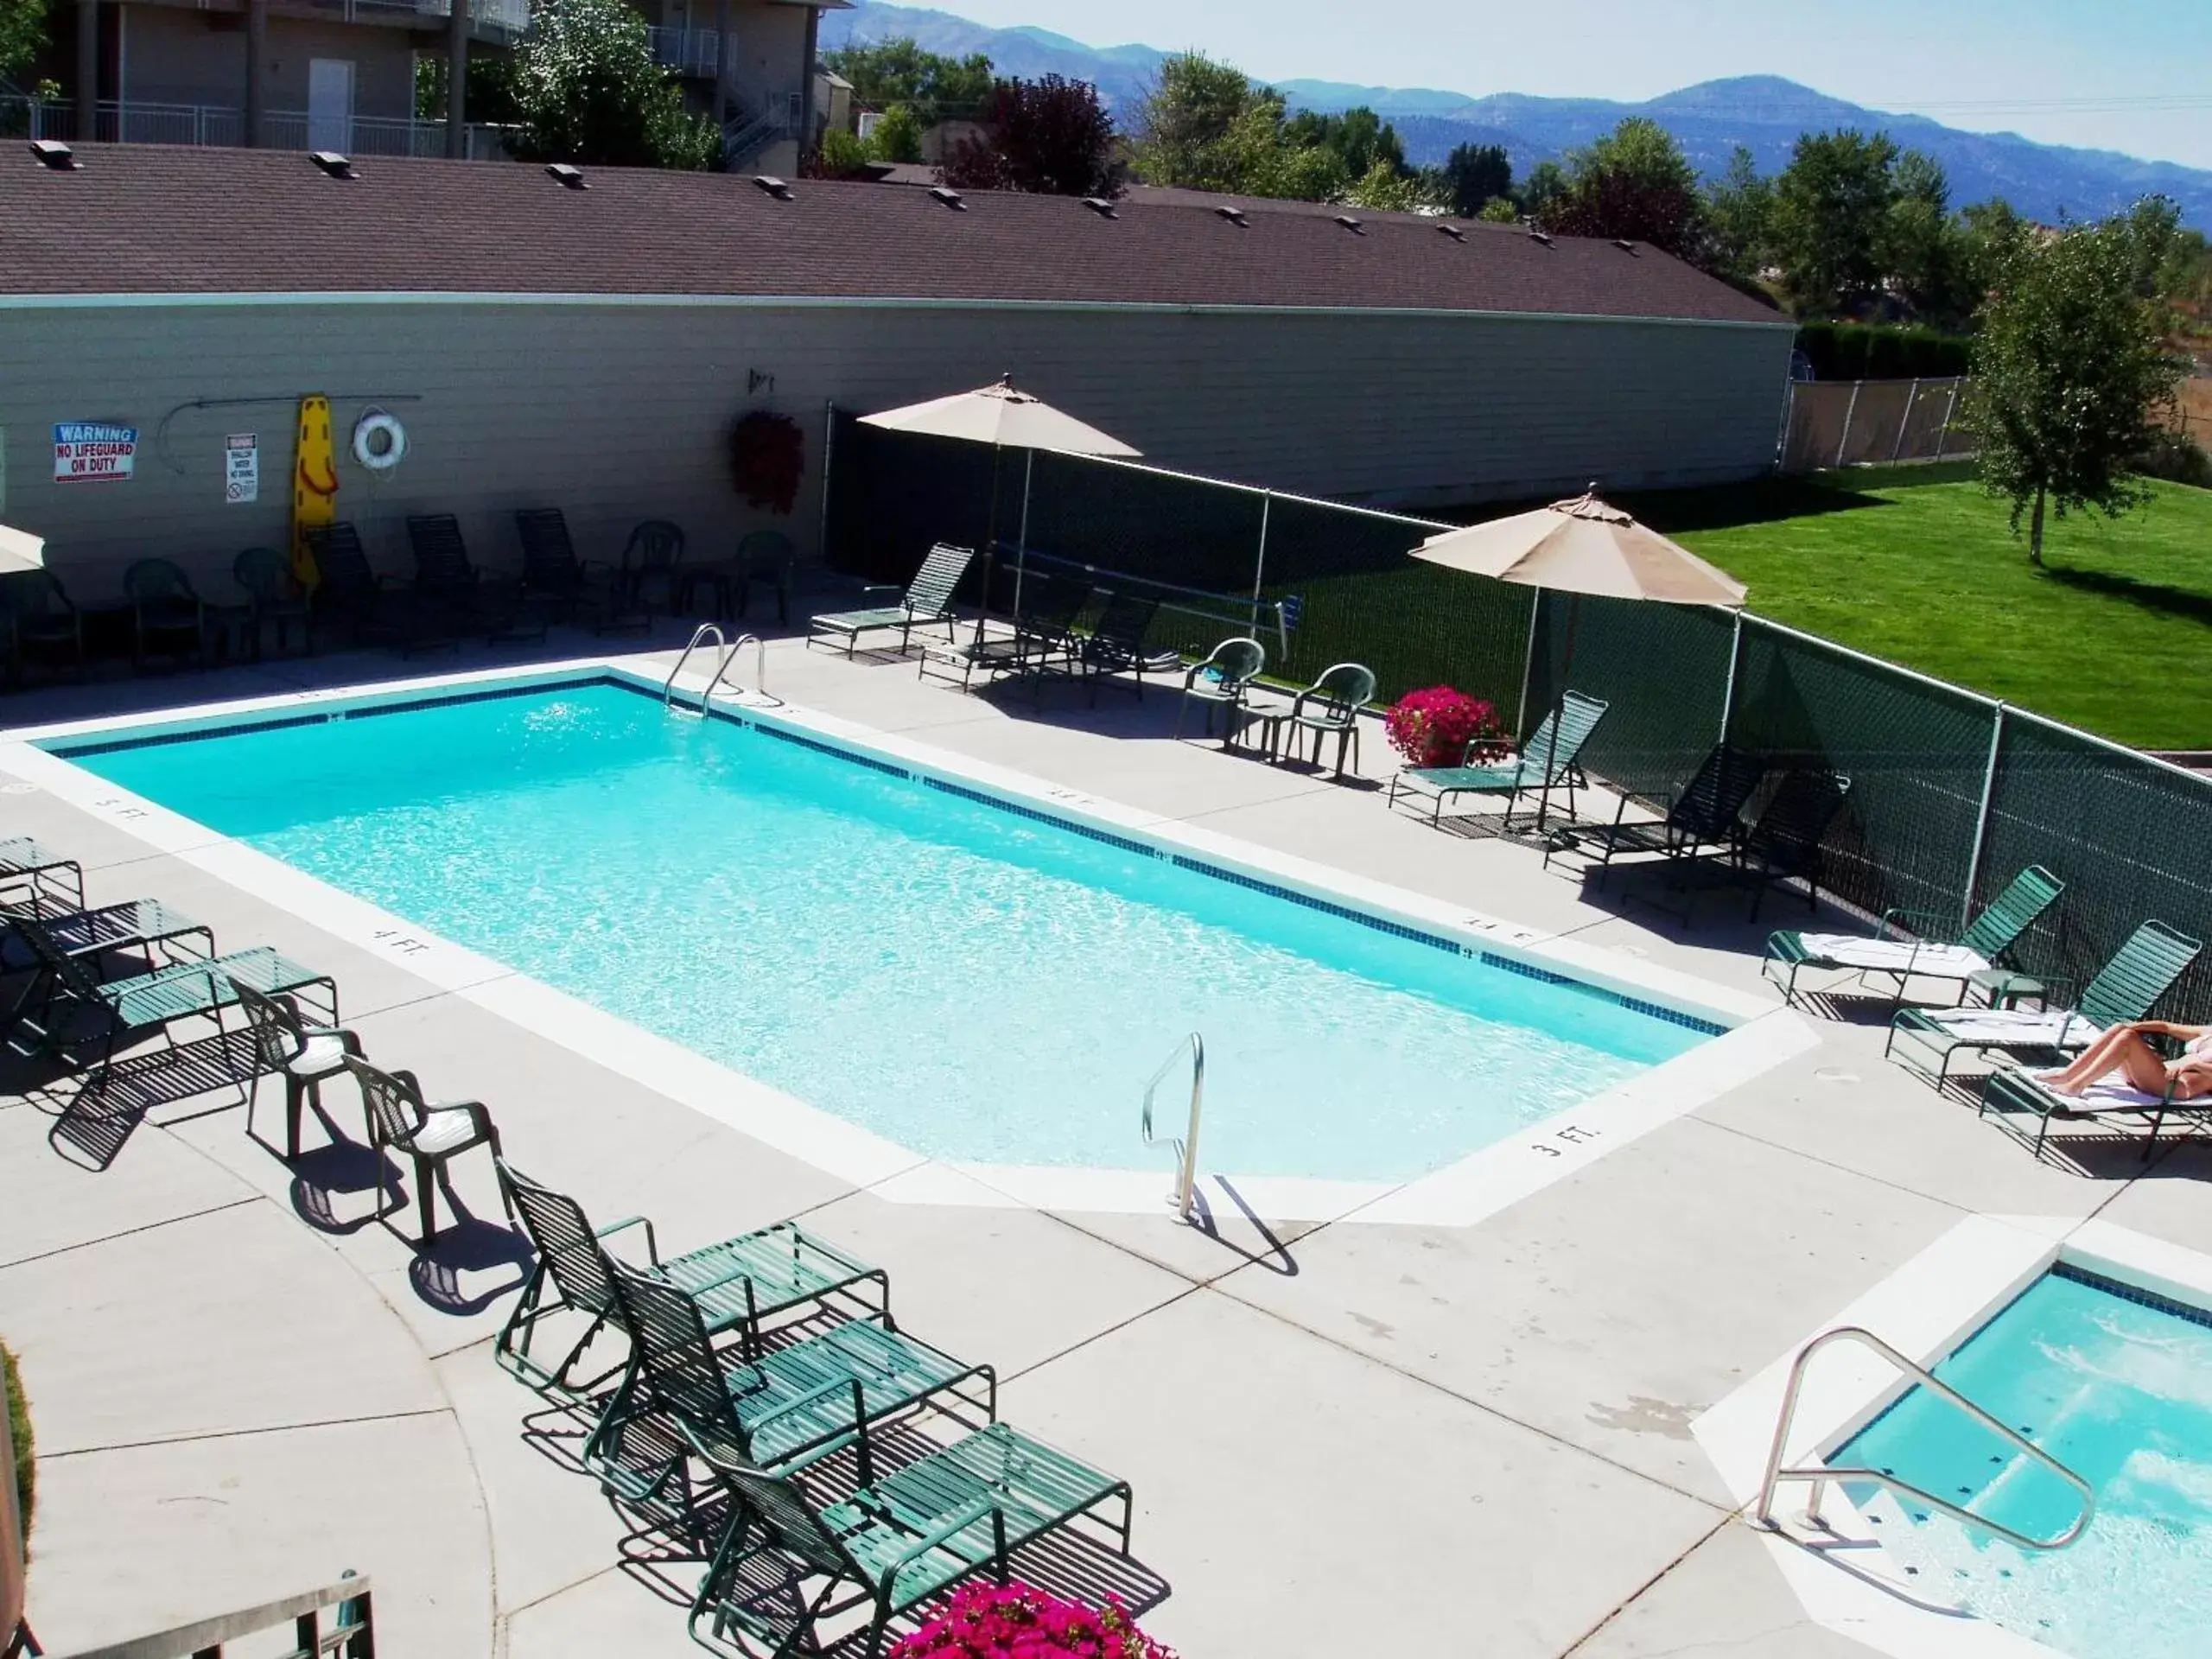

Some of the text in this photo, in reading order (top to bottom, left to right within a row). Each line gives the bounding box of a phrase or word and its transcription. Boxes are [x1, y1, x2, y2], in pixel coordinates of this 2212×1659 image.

[60, 425, 131, 442] WARNING
[57, 442, 133, 458] NO LIFEGUARD
[72, 457, 118, 473] ON DUTY
[1531, 1126, 1601, 1157] 3 FT.
